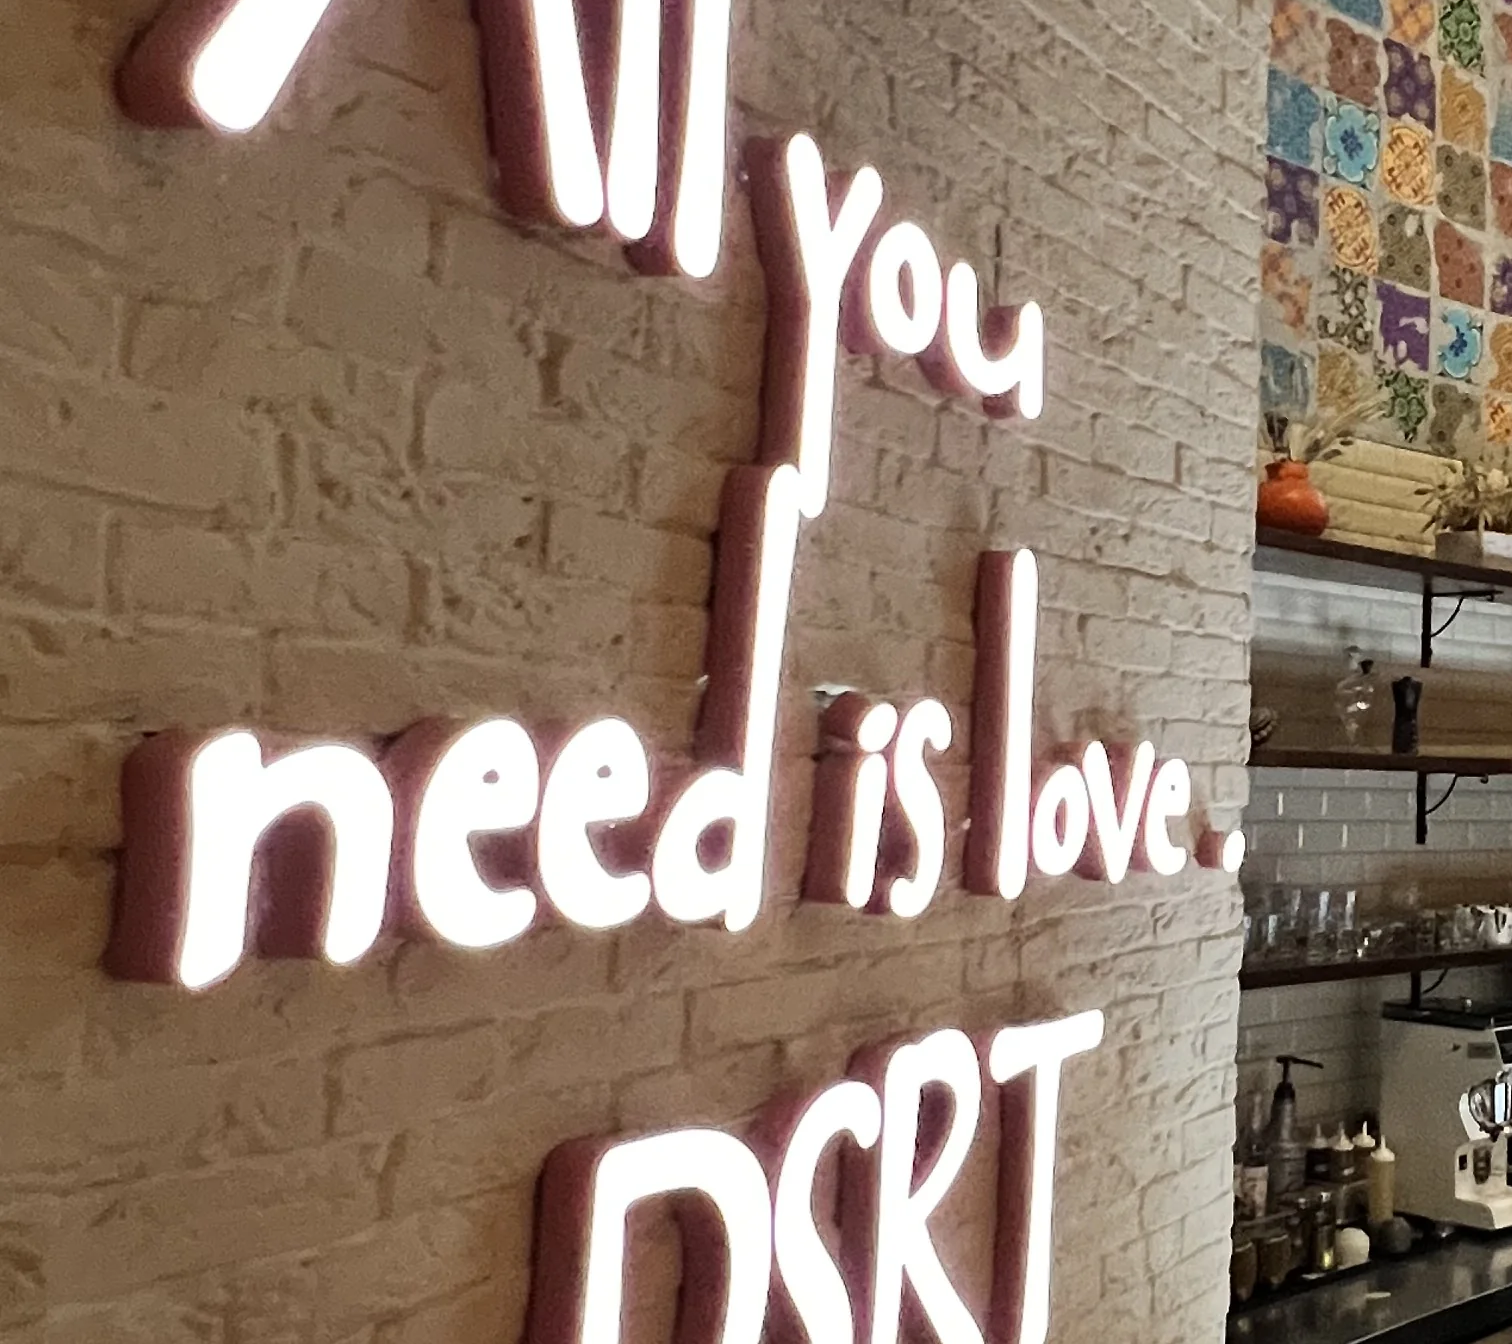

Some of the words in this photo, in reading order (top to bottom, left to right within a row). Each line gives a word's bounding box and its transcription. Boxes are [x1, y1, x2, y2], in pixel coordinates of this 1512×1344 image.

[784, 132, 1045, 519] you
[177, 462, 803, 989] need
[845, 697, 953, 919] is
[997, 547, 1246, 902] love.
